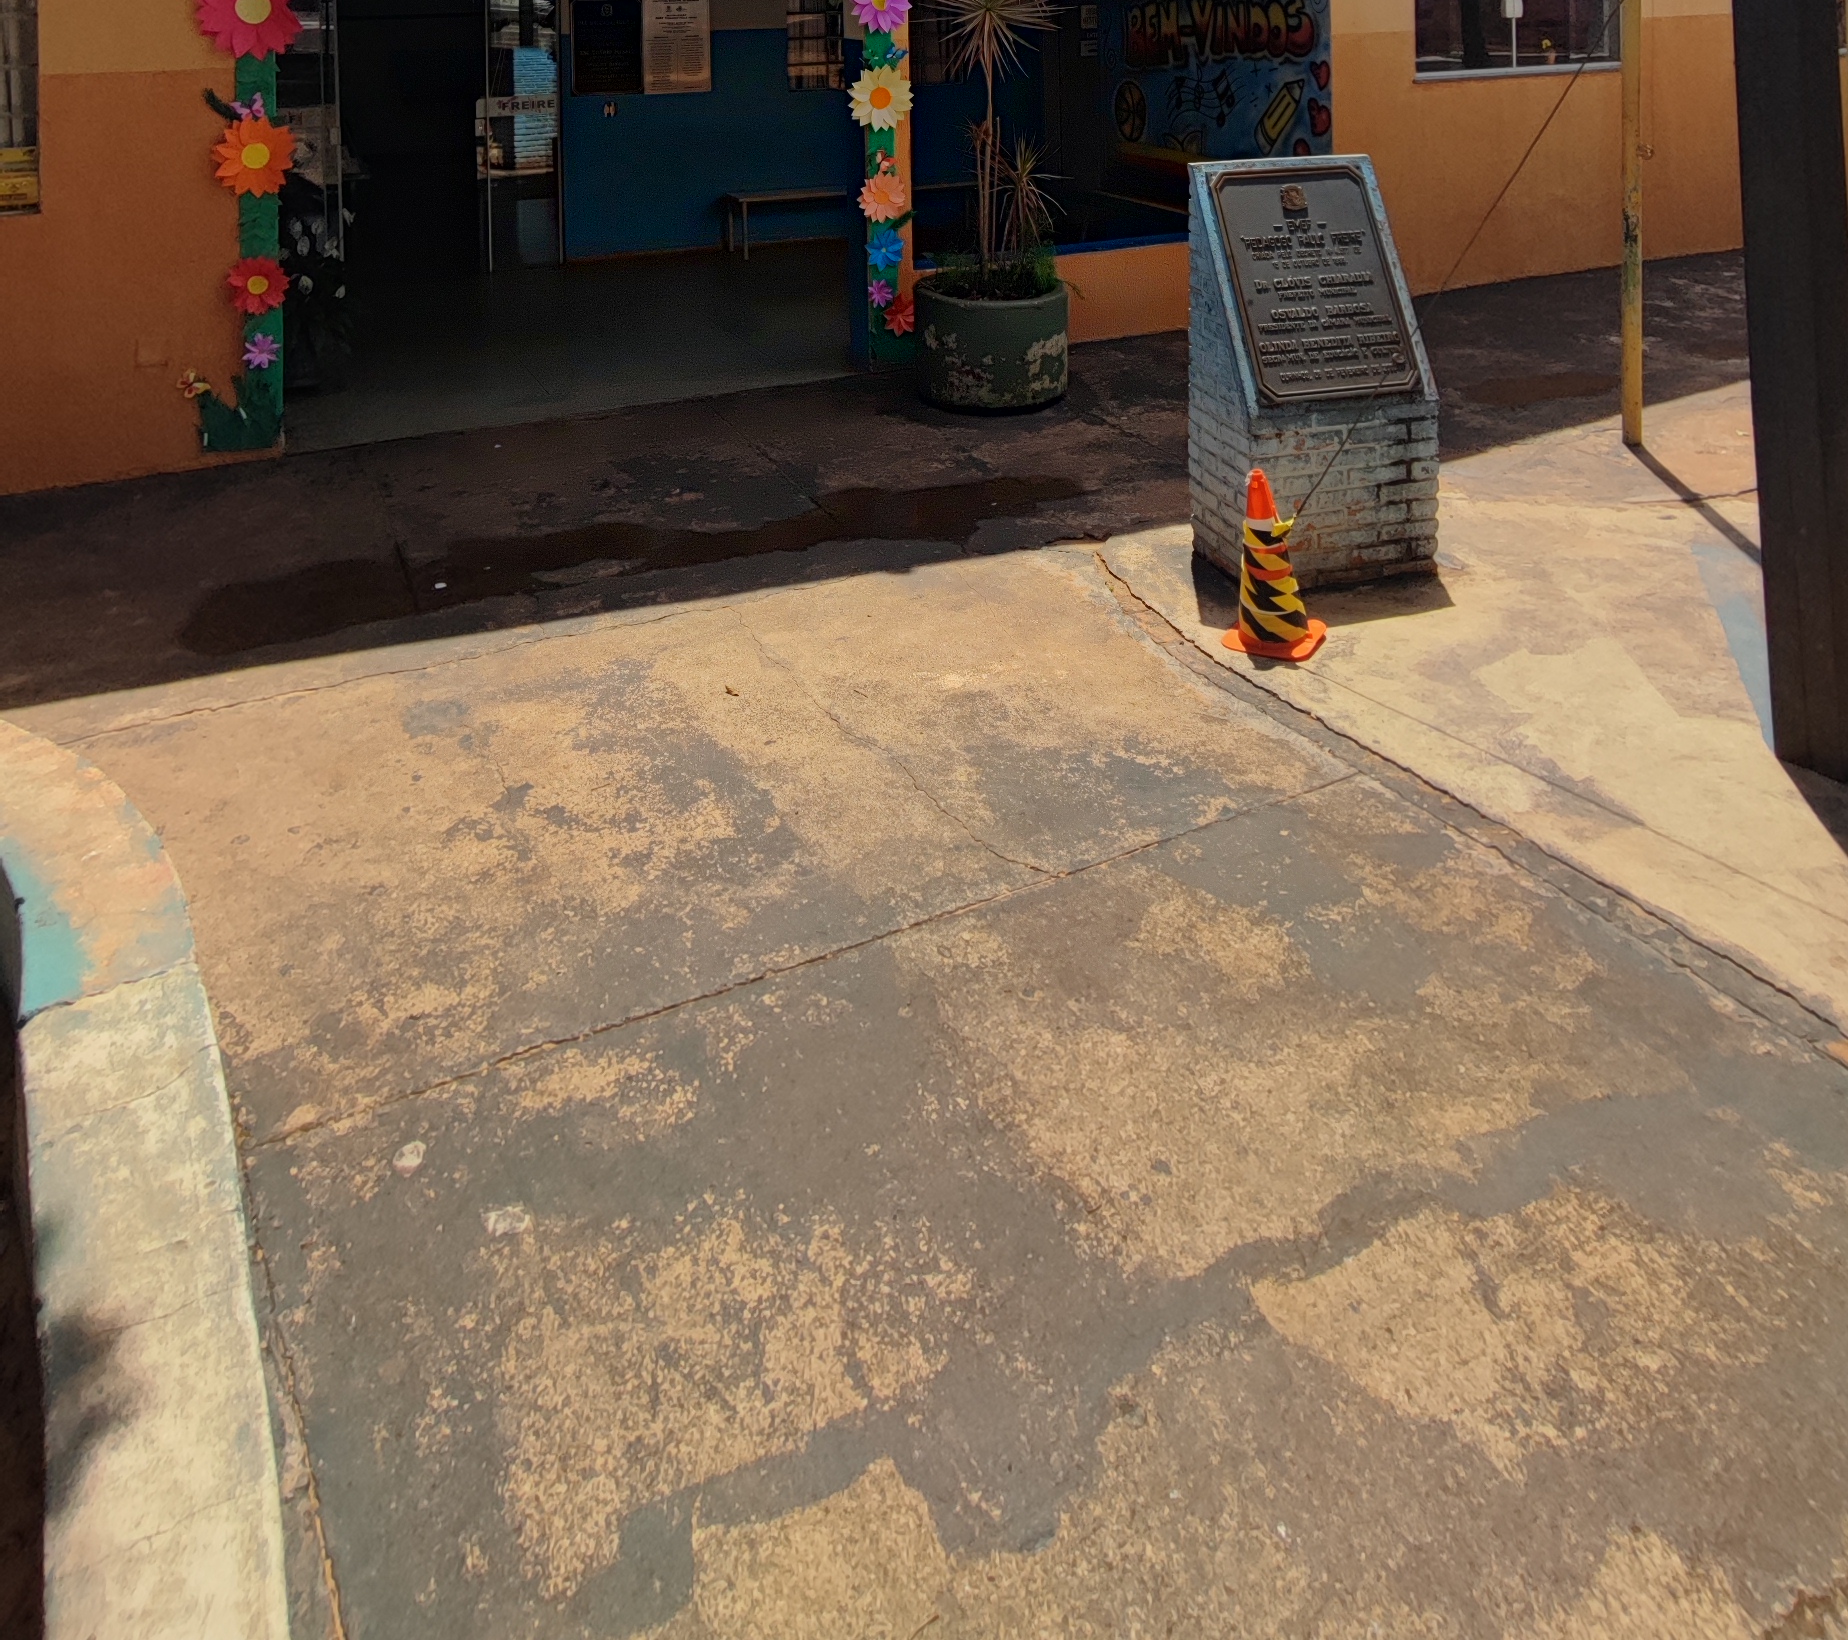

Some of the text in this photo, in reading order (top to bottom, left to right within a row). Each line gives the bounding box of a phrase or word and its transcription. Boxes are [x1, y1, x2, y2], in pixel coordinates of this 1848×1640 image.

[502, 99, 556, 111] FREIRE
[1286, 219, 1311, 231] EMEF
[1297, 233, 1325, 246] PAULO
[1273, 275, 1312, 289] CLÓVIS
[1270, 303, 1373, 320] OSVALDO BARBOSA
[1258, 321, 1306, 332] PRESIDENTE
[1259, 331, 1401, 353] OLINDA BENEDITA RIBEIRO
